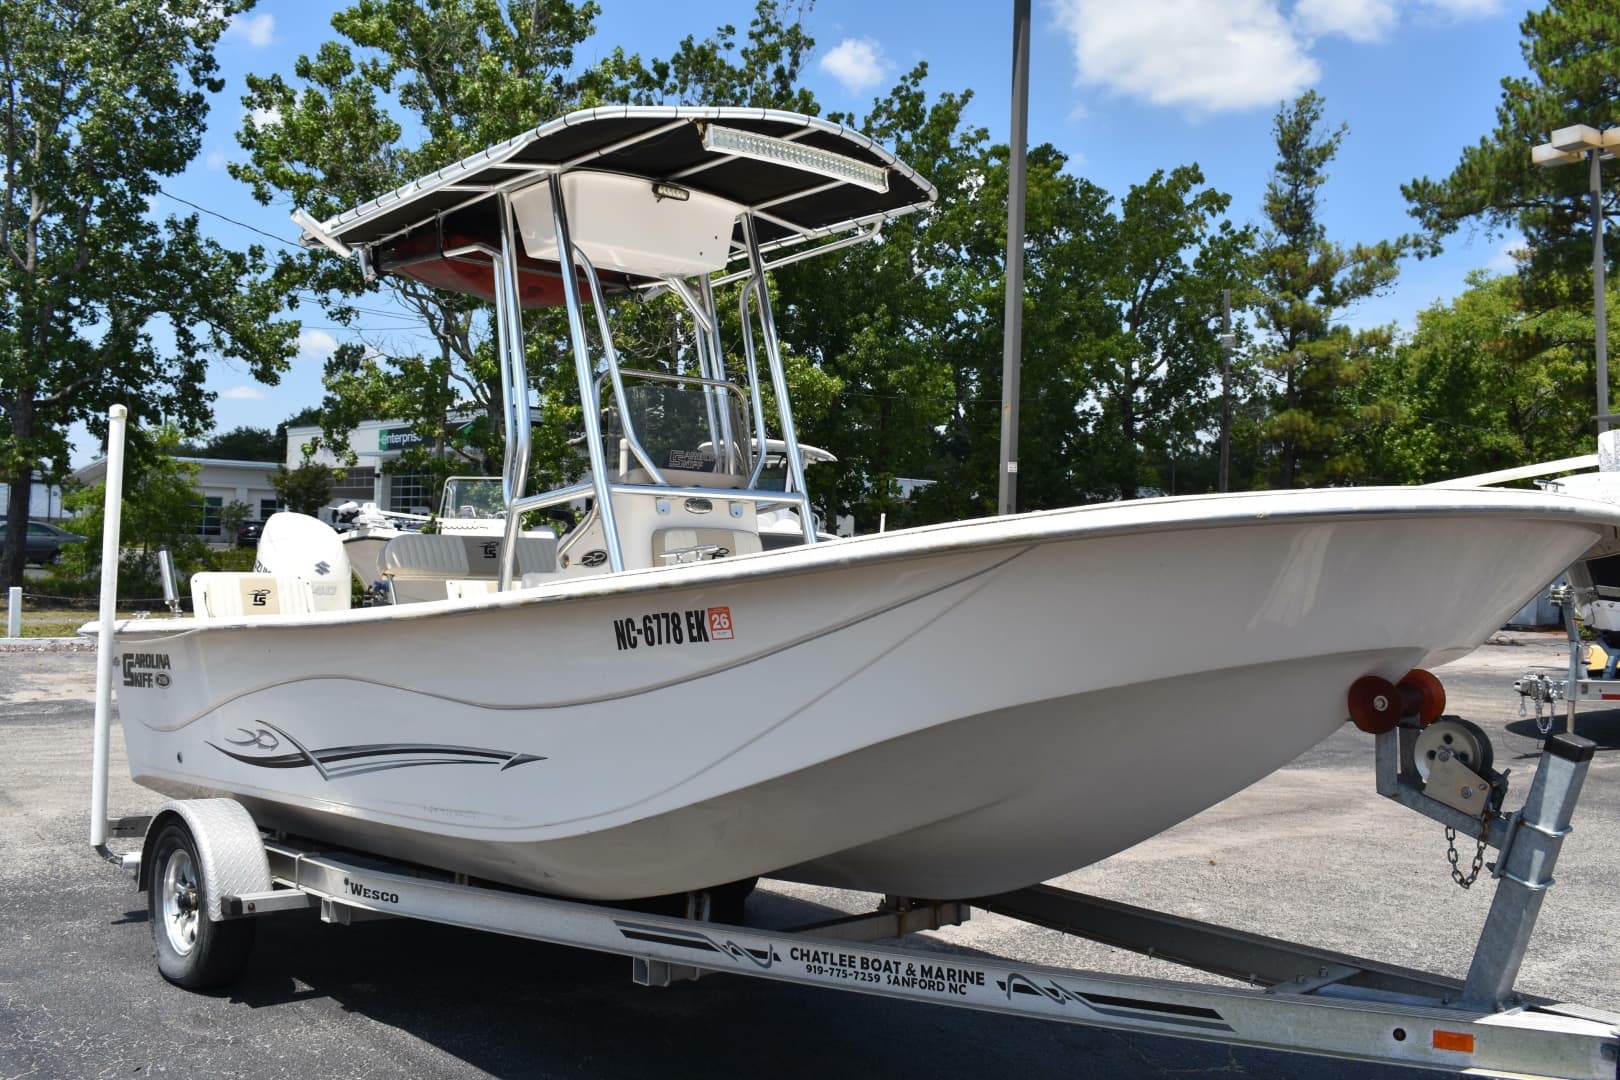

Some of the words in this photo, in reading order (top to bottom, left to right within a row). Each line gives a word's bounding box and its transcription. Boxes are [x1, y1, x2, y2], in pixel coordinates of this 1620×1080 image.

[613, 611, 684, 650] NC-6778
[685, 609, 710, 643] EK
[711, 612, 730, 629] 26
[122, 653, 171, 670] CAROLINA
[123, 671, 154, 688] SKIFF
[350, 882, 399, 904] WESCO
[790, 947, 857, 969] CHATLEE
[860, 956, 902, 975] BOAT
[905, 962, 917, 977] &
[920, 964, 985, 986] MARINE
[805, 964, 881, 983] 919-775-7259
[886, 974, 945, 992] SANFORD
[948, 983, 967, 996] NC
